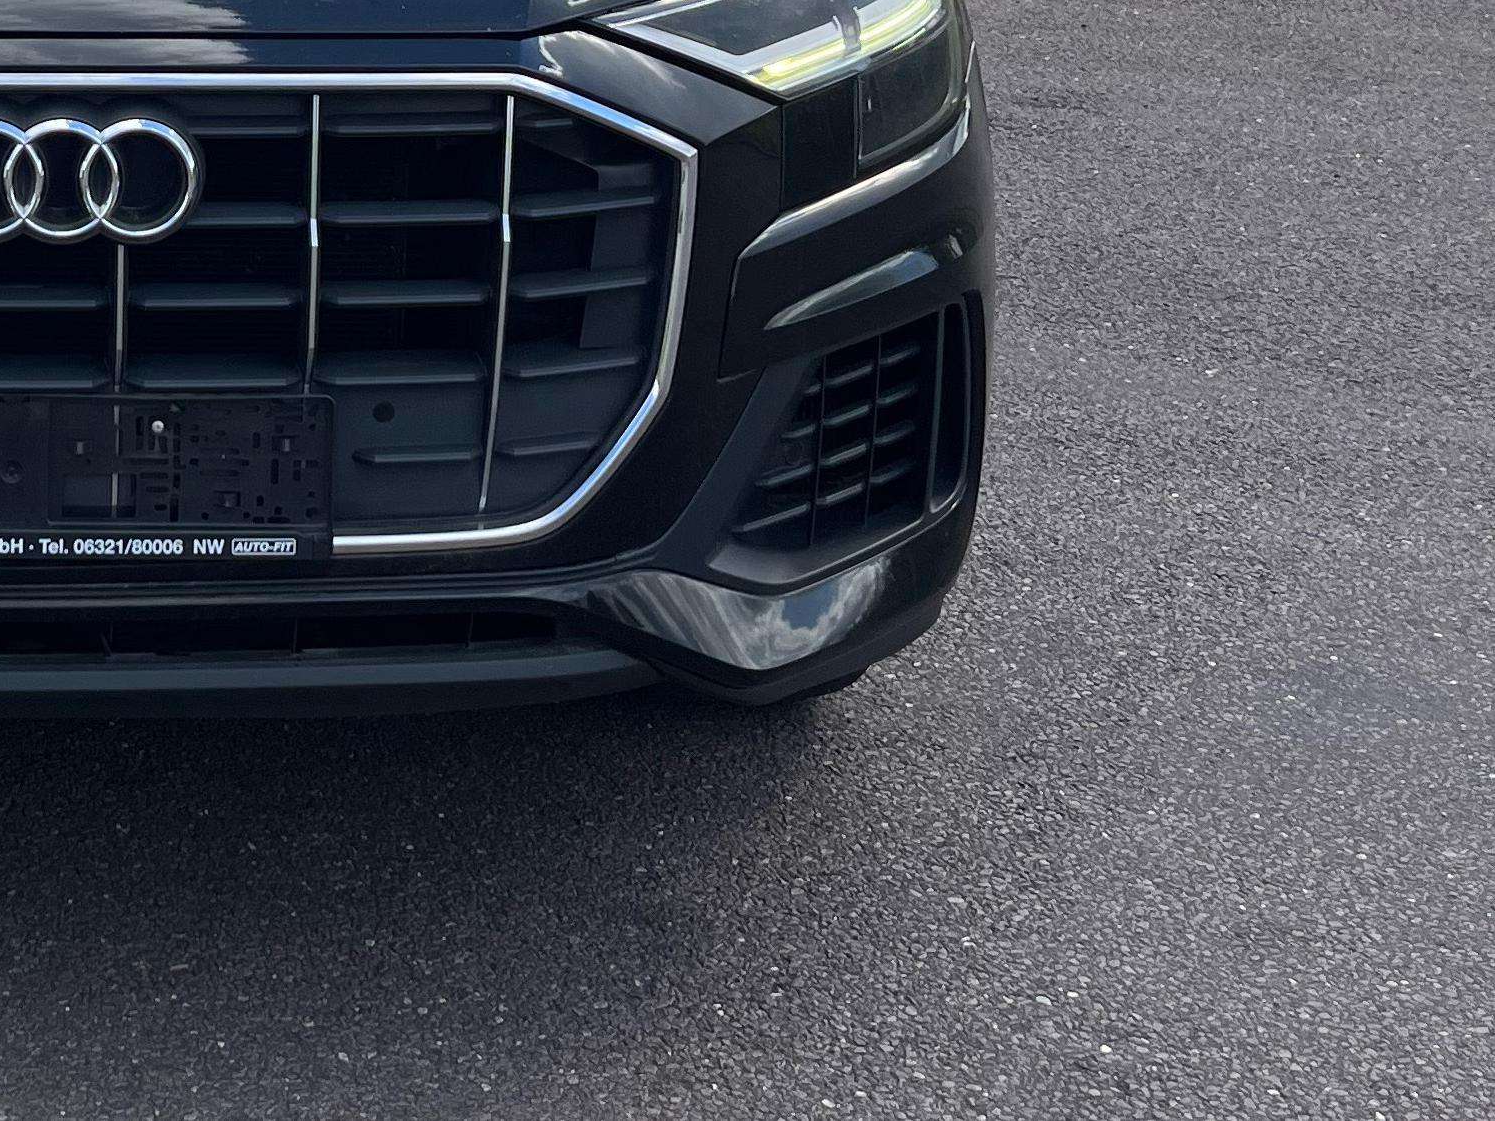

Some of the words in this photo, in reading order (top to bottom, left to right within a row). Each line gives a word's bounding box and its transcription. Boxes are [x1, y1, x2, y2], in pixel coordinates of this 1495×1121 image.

[39, 538, 68, 555] Tel.
[73, 538, 184, 555] 06321/80006
[193, 538, 225, 555] NW
[233, 541, 294, 553] AUTO-FIT
